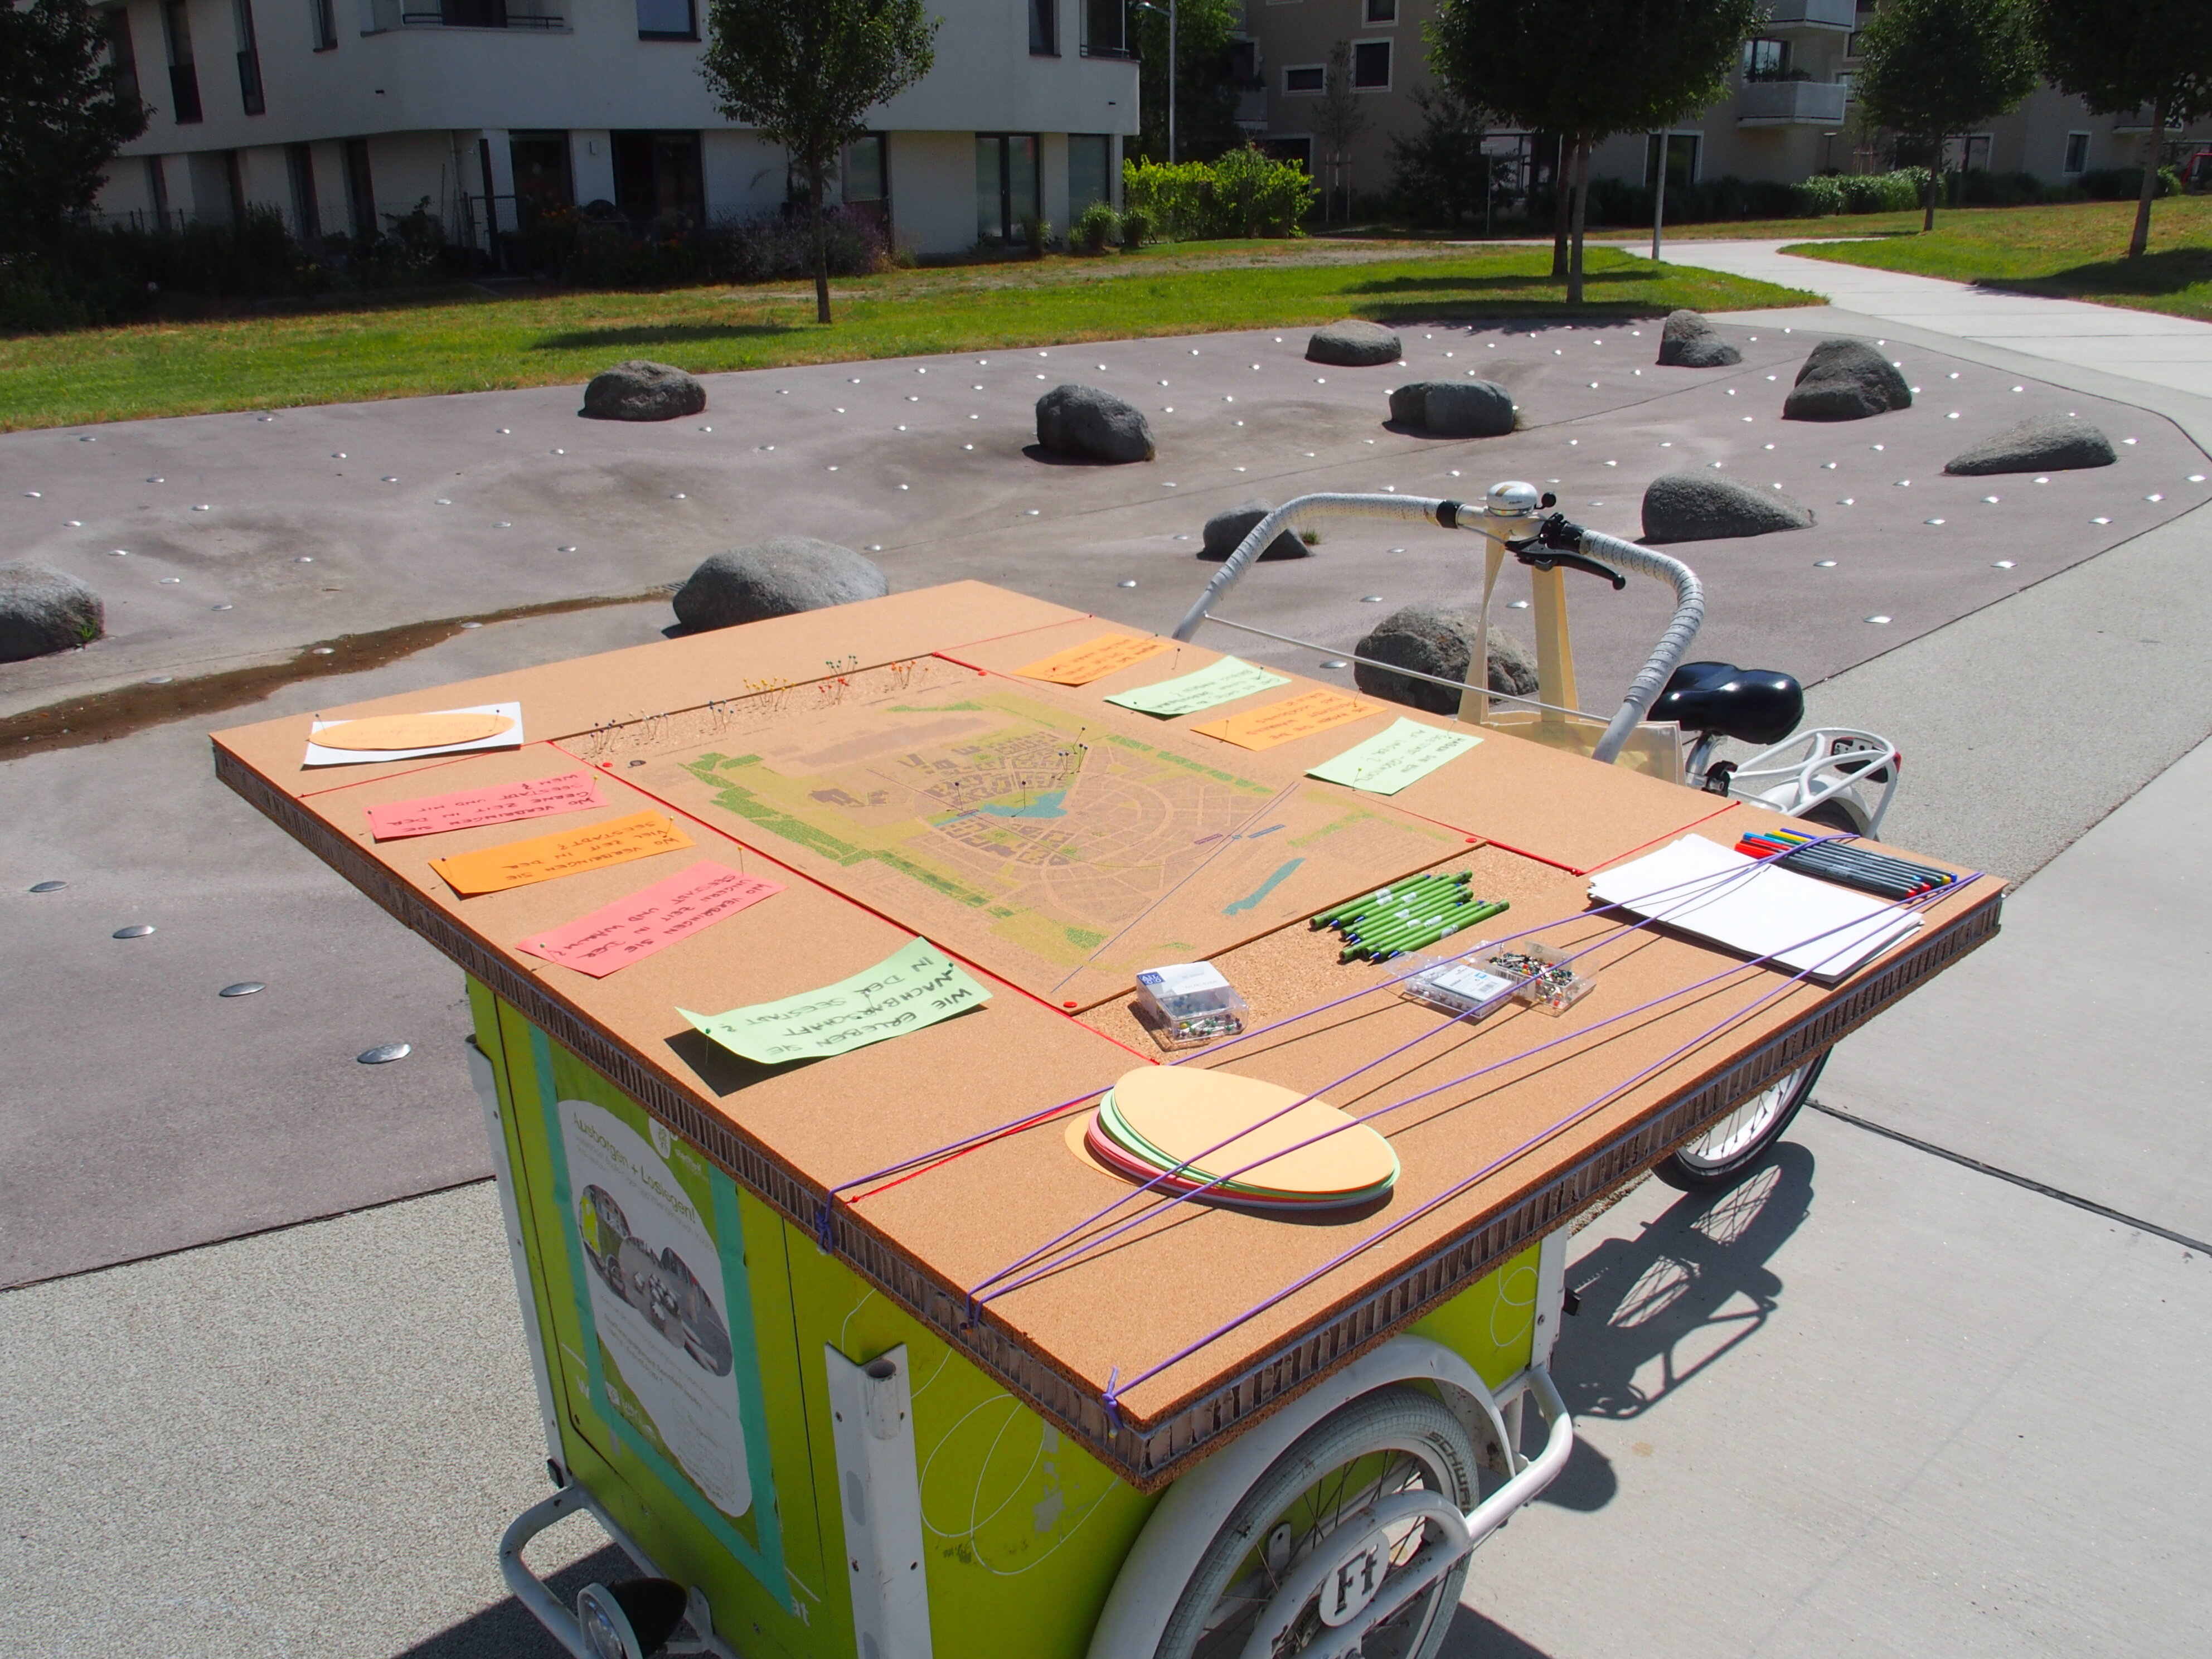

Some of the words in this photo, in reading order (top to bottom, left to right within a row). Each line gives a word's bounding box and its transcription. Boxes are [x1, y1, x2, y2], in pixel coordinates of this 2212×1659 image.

[1371, 740, 1405, 755] LAGER
[1435, 738, 1466, 752] HABEN
[1418, 755, 1436, 763] SIE
[498, 784, 584, 800] SEESTADT
[532, 791, 589, 803] GERNE
[474, 803, 517, 812] ZEIT
[568, 797, 594, 806] WO
[386, 817, 428, 826] DER
[449, 805, 554, 825] VERBRINGEN
[633, 830, 666, 838] VIEL
[653, 837, 680, 846] WO
[590, 840, 622, 851] ZEIT
[501, 860, 544, 870] DER
[545, 846, 642, 871] VERBRINGEN
[671, 874, 736, 904] SEESTADT
[700, 879, 753, 902] UNGERN
[746, 883, 772, 895] WO
[628, 907, 659, 922] UND
[659, 906, 695, 921] ZEIT
[663, 897, 741, 934] VERBRINGEN
[633, 926, 651, 934] IN
[576, 940, 625, 959] DER
[623, 938, 654, 953] SIE
[911, 957, 934, 972] IN
[853, 973, 905, 997] DER
[782, 972, 952, 1036] NACHBARSCHAFT
[932, 987, 972, 1010] WIE
[745, 996, 847, 1025] SEESTADT
[816, 1011, 917, 1047] ERLEBEN
[765, 1045, 803, 1055] SIE
[573, 1112, 629, 1169] Ausborgen
[640, 1165, 696, 1224] Loslegen!
